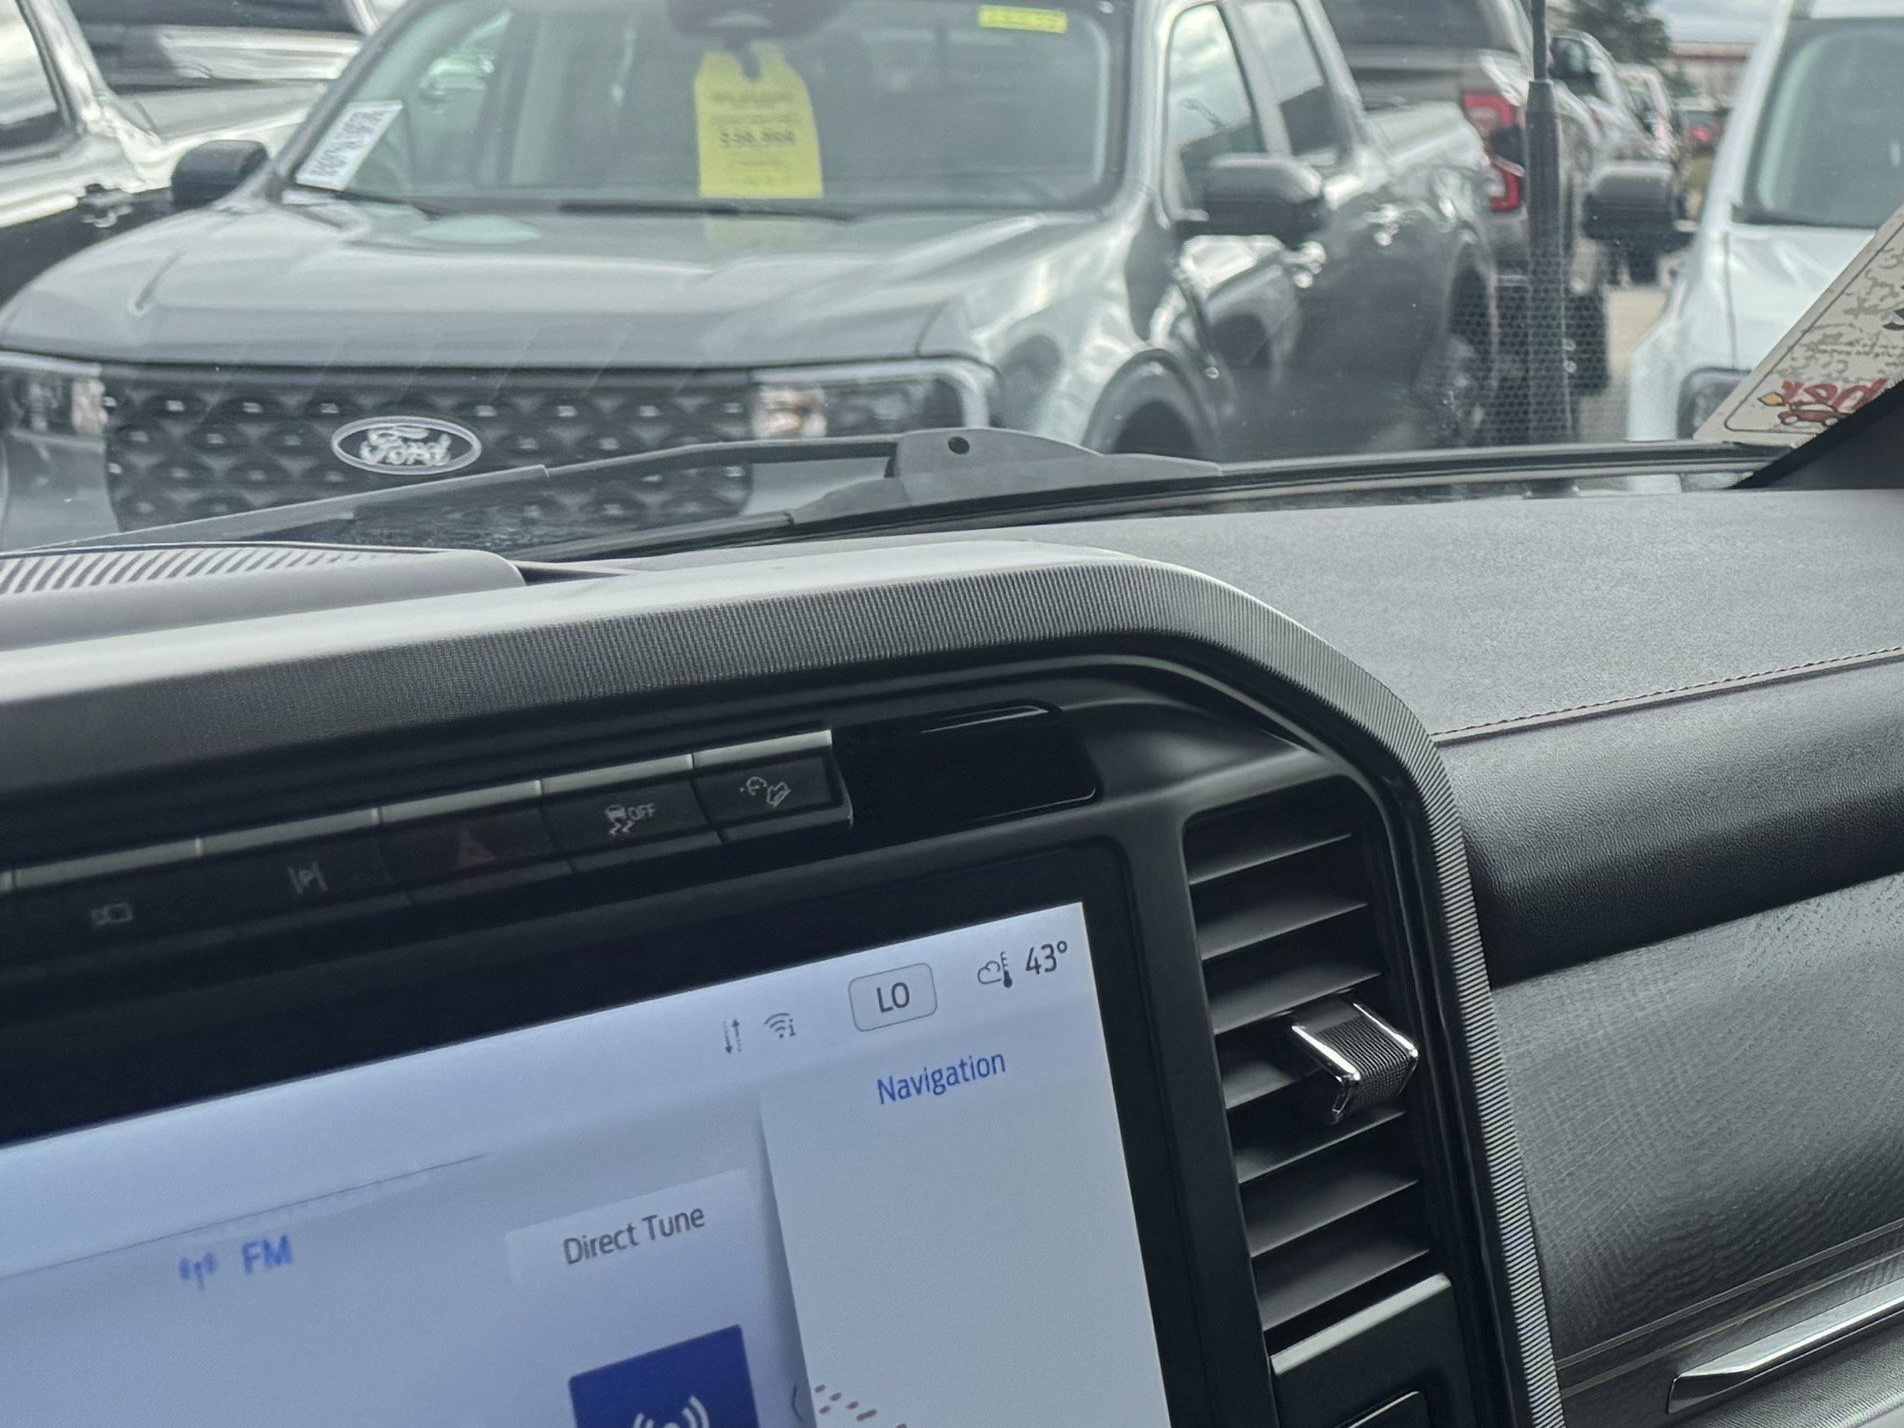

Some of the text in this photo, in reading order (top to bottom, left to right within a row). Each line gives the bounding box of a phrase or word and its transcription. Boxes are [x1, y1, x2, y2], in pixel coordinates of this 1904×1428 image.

[358, 424, 452, 468] Ford
[627, 802, 656, 822] OFF
[876, 982, 911, 1013] LO
[877, 1050, 1007, 1105] Navigation
[241, 1233, 295, 1274] FM
[564, 1205, 706, 1265] Direct Tune
